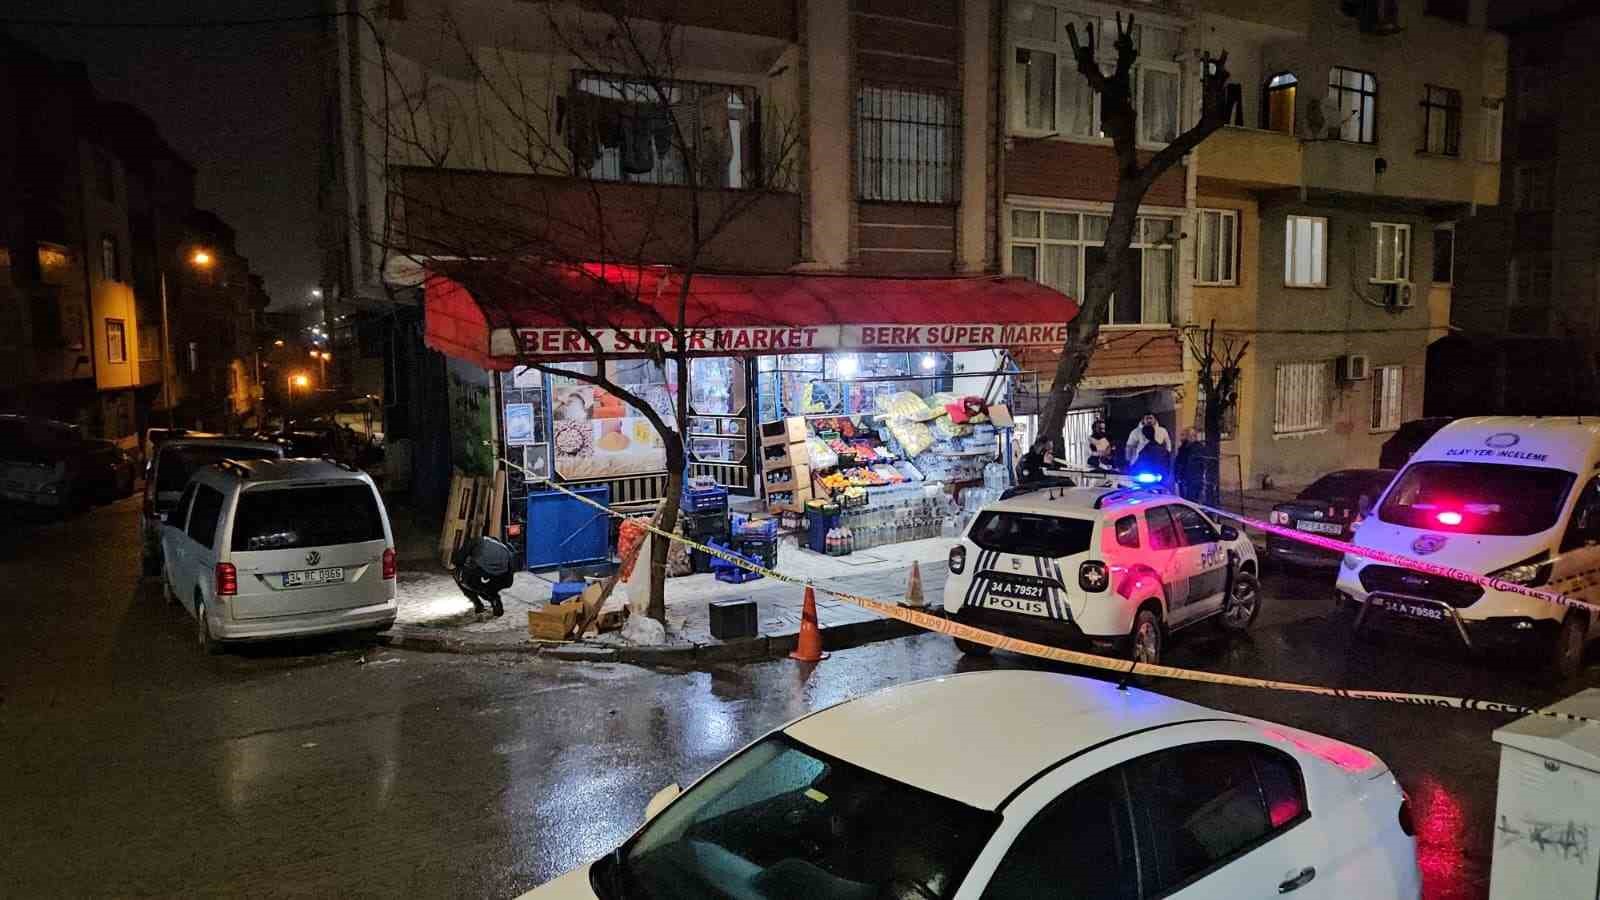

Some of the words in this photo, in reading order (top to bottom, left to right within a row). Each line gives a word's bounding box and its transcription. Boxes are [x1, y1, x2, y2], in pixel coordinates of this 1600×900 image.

[712, 328, 818, 349] MARKET
[861, 326, 921, 345] BERK
[1000, 326, 1067, 345] MARKE
[991, 582, 1002, 592] 34
[1004, 583, 1012, 593] A
[1014, 585, 1043, 598] 79521
[989, 597, 1042, 613] POLIS
[1399, 603, 1408, 613] A
[1409, 606, 1442, 620] 79582
